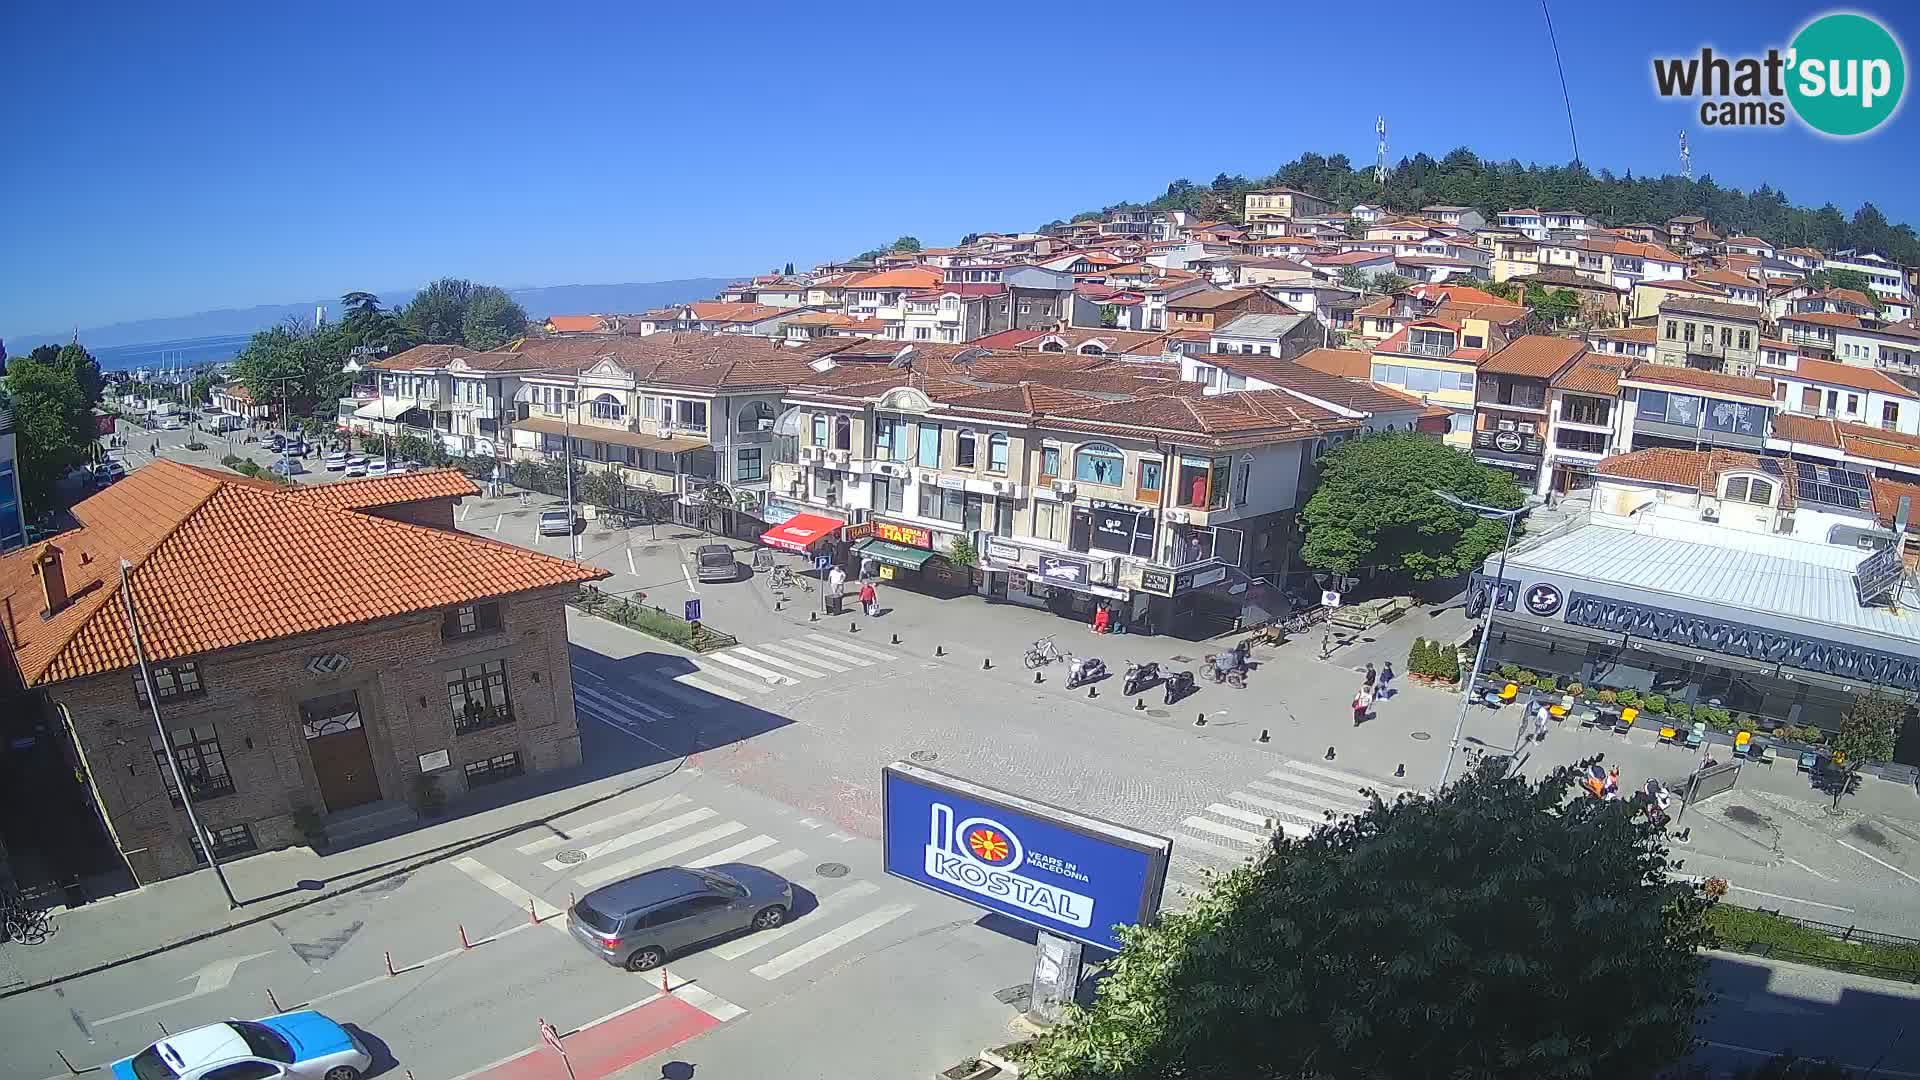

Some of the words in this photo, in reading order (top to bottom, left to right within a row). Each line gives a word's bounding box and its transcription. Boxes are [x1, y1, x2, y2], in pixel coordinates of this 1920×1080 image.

[1027, 857, 1090, 883] MACEDONIA
[1028, 850, 1063, 867] YEARS
[1065, 861, 1077, 871] IN
[935, 852, 1080, 920] KOSTAL
